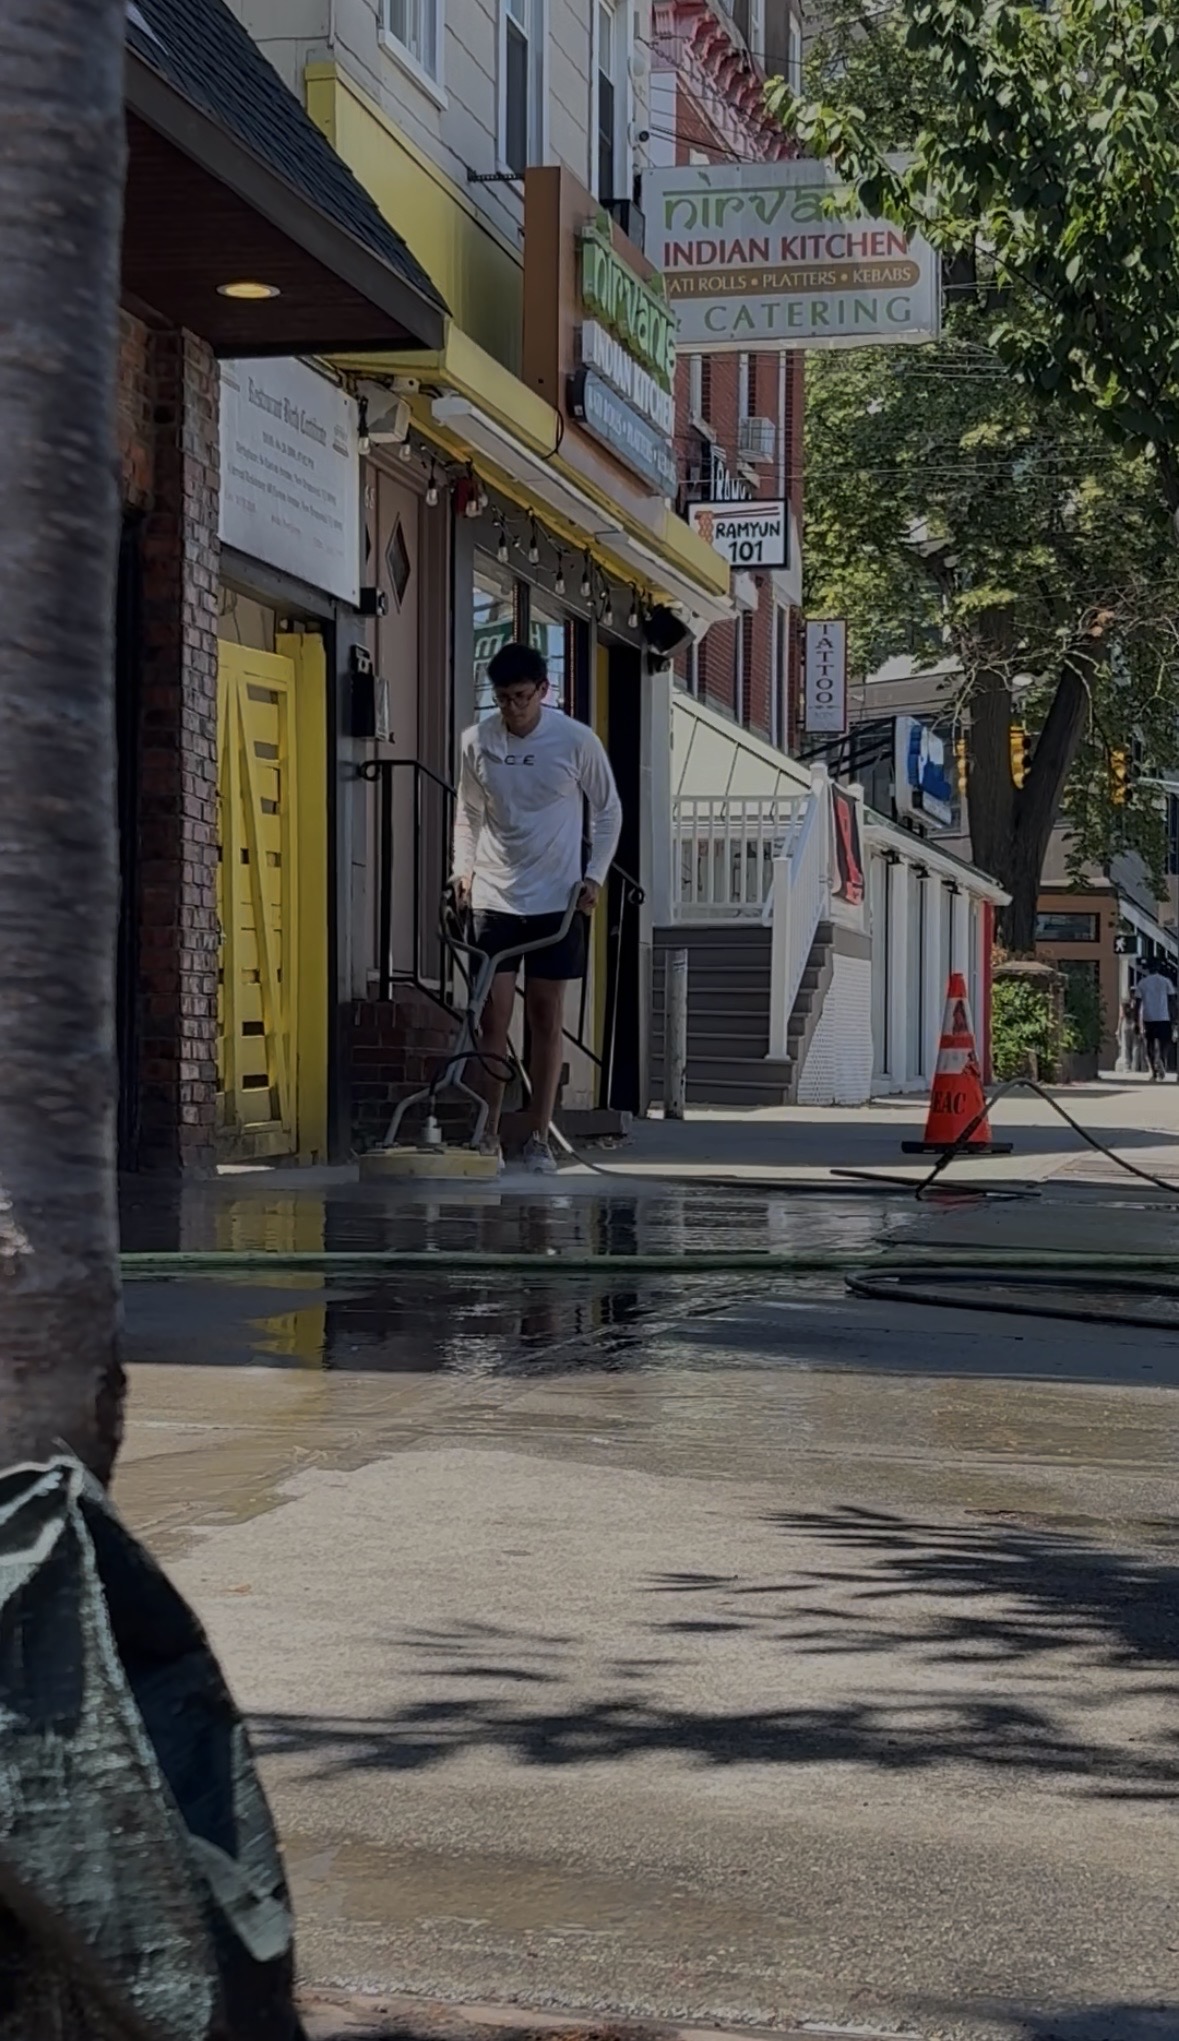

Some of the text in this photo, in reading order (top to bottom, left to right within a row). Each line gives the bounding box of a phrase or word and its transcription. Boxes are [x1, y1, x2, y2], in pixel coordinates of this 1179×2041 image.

[663, 180, 848, 231] nirva
[664, 230, 908, 267] INDIAN KITCHEN
[667, 267, 911, 294] ATI ROLLS PLATTERS KEBABS
[705, 296, 912, 332] CATERING
[715, 520, 781, 540] RAMYUN
[728, 540, 763, 563] 101
[815, 623, 834, 704] TATTOO
